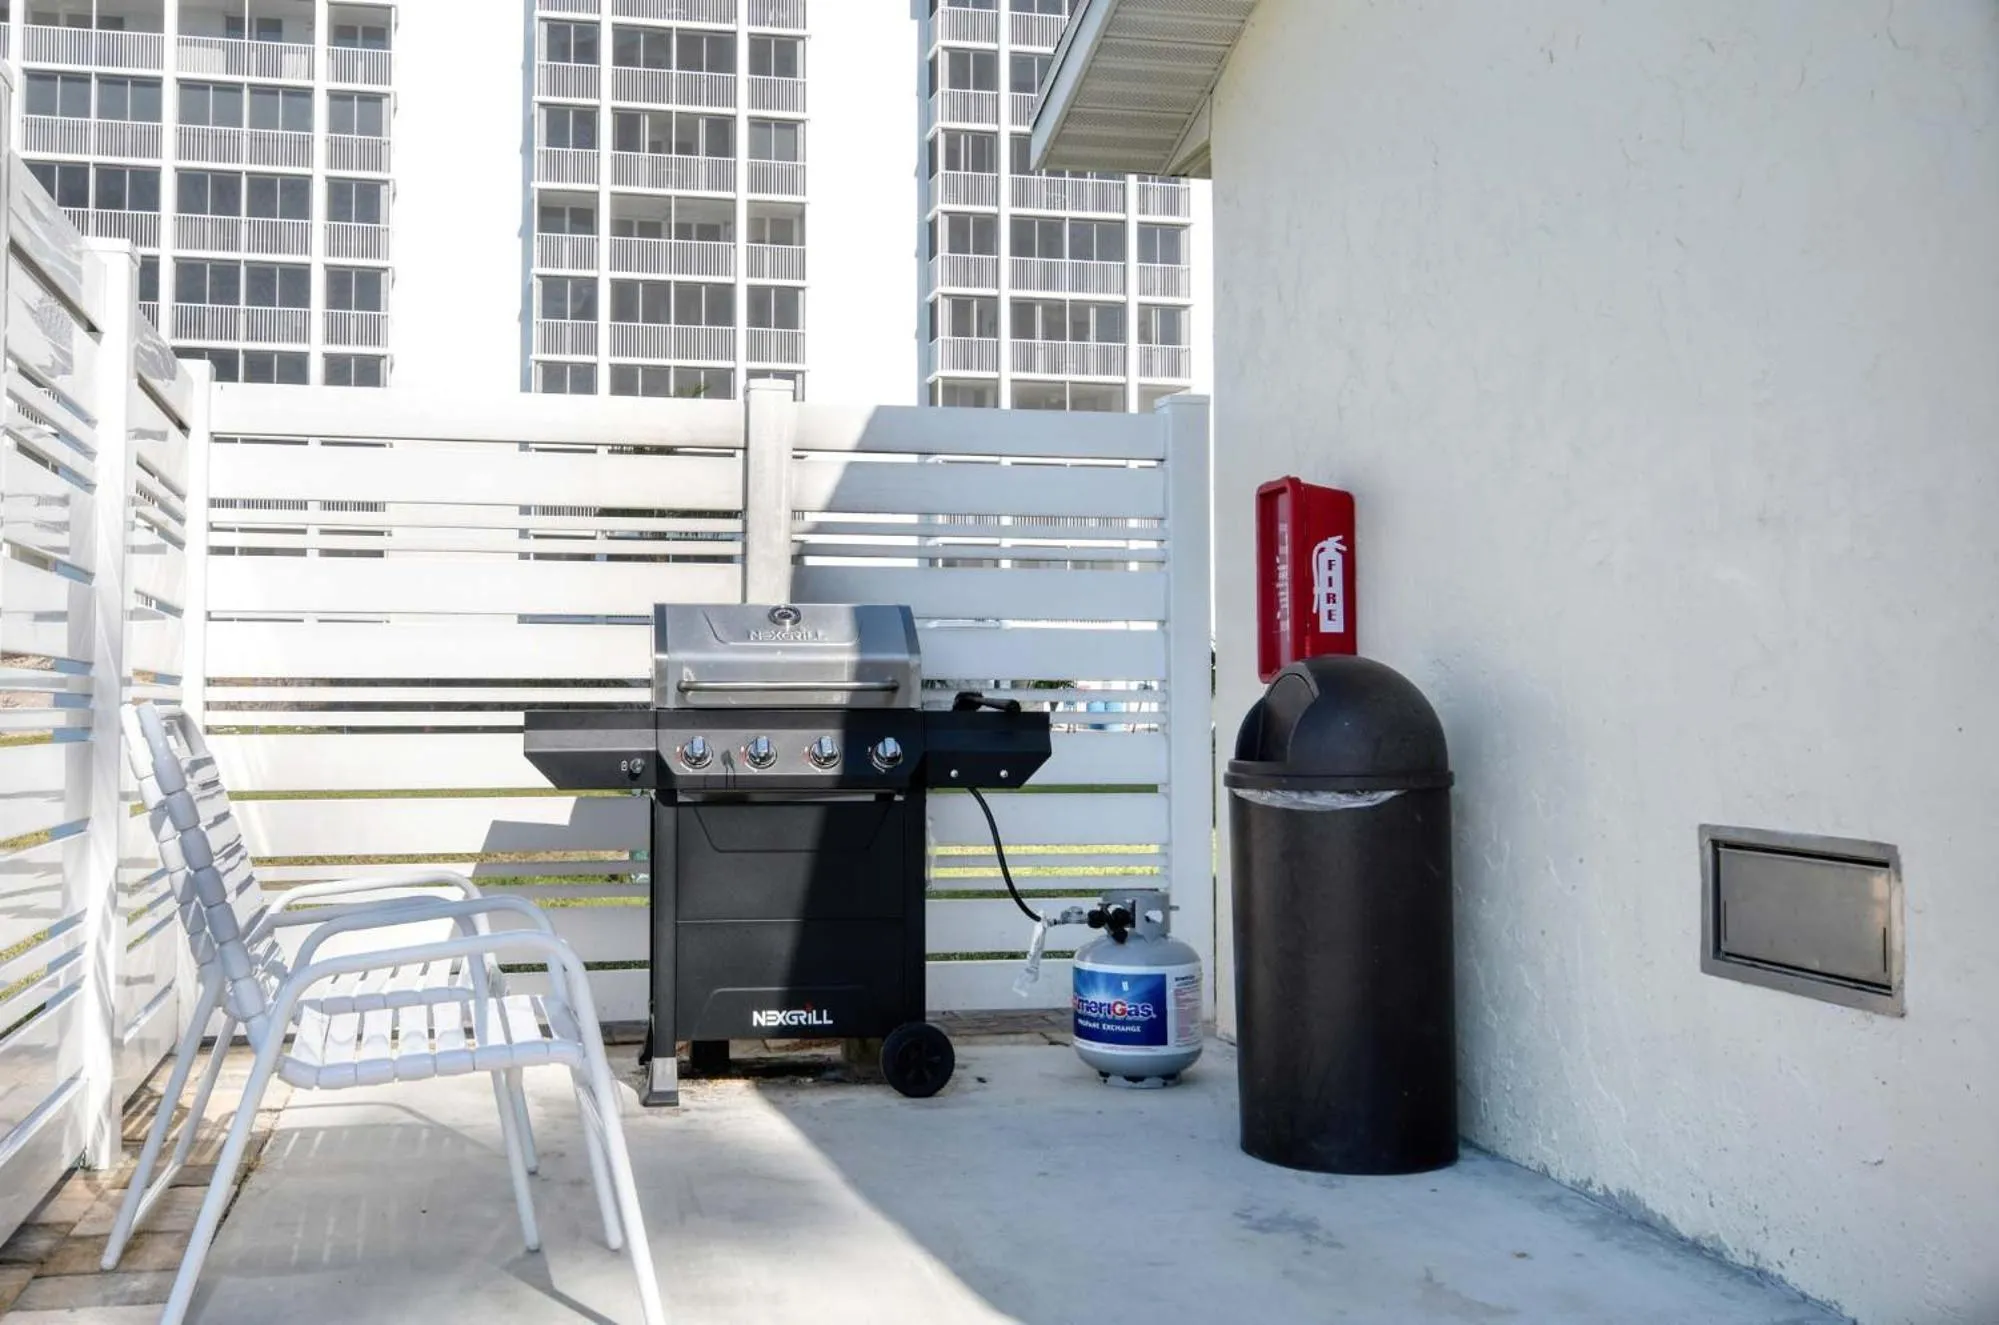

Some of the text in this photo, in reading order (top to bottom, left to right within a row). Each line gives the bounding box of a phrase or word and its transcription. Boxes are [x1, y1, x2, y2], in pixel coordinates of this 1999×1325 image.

[1326, 559, 1337, 622] FIRE
[752, 1009, 834, 1027] NEXGRILL
[1102, 1022, 1142, 1033] EXCHANGE
